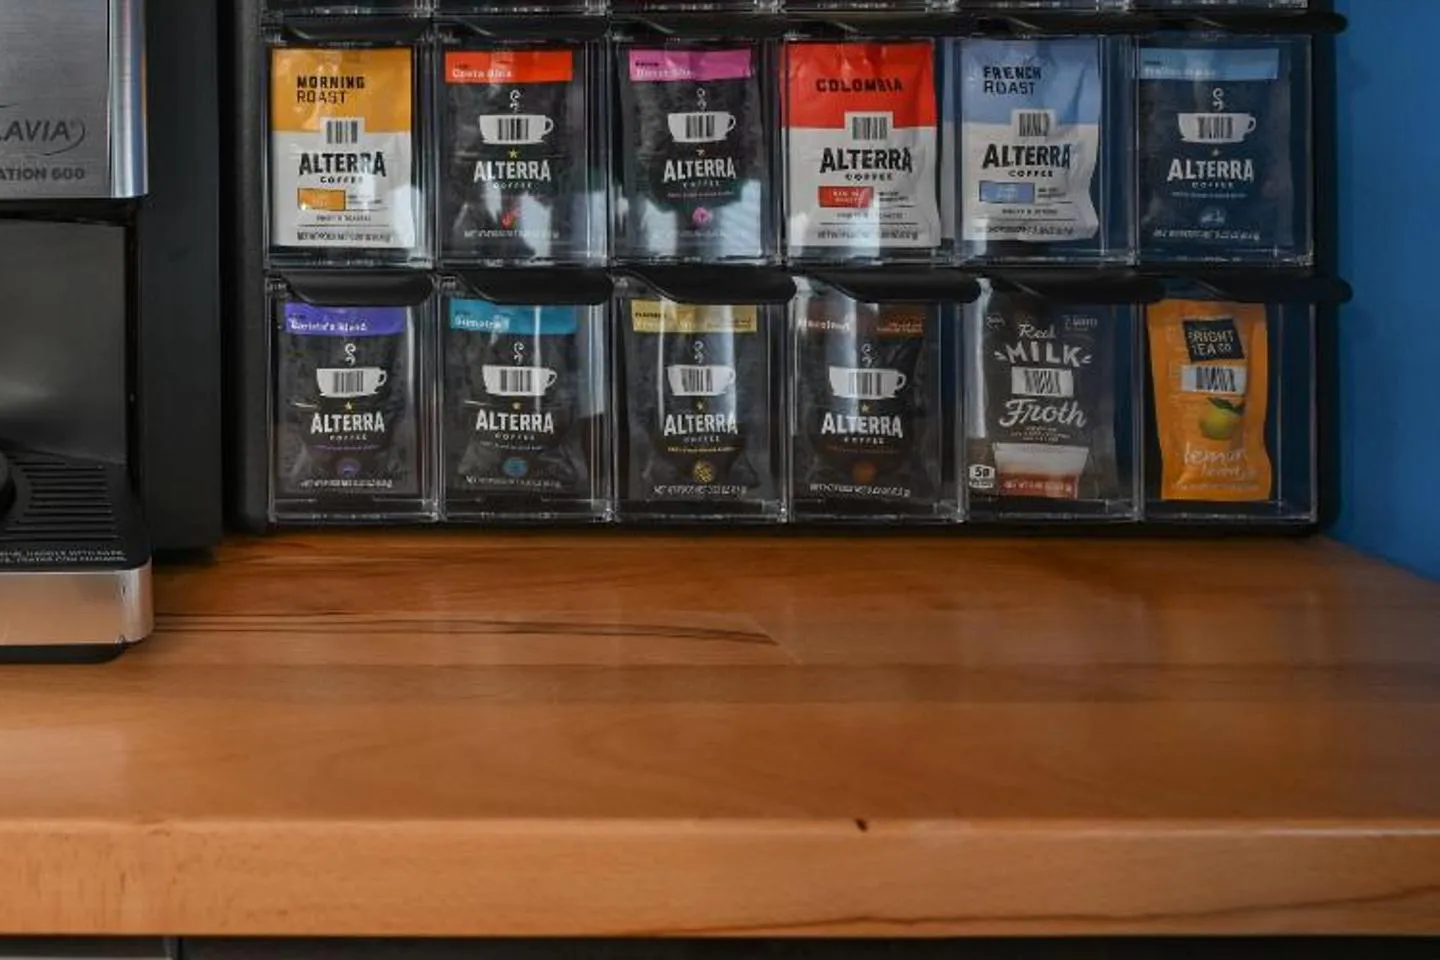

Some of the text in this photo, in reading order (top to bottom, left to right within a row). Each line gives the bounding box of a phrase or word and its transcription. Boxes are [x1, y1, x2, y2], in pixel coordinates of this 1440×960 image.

[297, 76, 365, 89] MORNING
[983, 65, 1042, 80] FRENCH
[297, 90, 348, 104] ROAST
[816, 78, 903, 93] COLOMBIA
[983, 80, 1036, 95] ROAST
[299, 152, 387, 177] ALTERRA
[820, 147, 913, 174] ALTERRA
[982, 143, 1072, 170] ALTERRA
[52, 167, 86, 181] 600
[474, 159, 552, 182] ALTERRA
[663, 157, 737, 183] ALTERRA
[845, 173, 894, 182] COFFEE
[1008, 170, 1053, 178] COFFEE
[1167, 158, 1254, 182] ALTERRA
[1019, 323, 1056, 339] Real
[1006, 341, 1082, 367] MILK
[1192, 343, 1216, 356] TEA
[310, 411, 385, 434] ALTERRA
[476, 409, 554, 434] ALTERRA
[999, 398, 1087, 428] Froth
[664, 413, 738, 437] ALTERRA
[821, 412, 903, 439] ALTERRA
